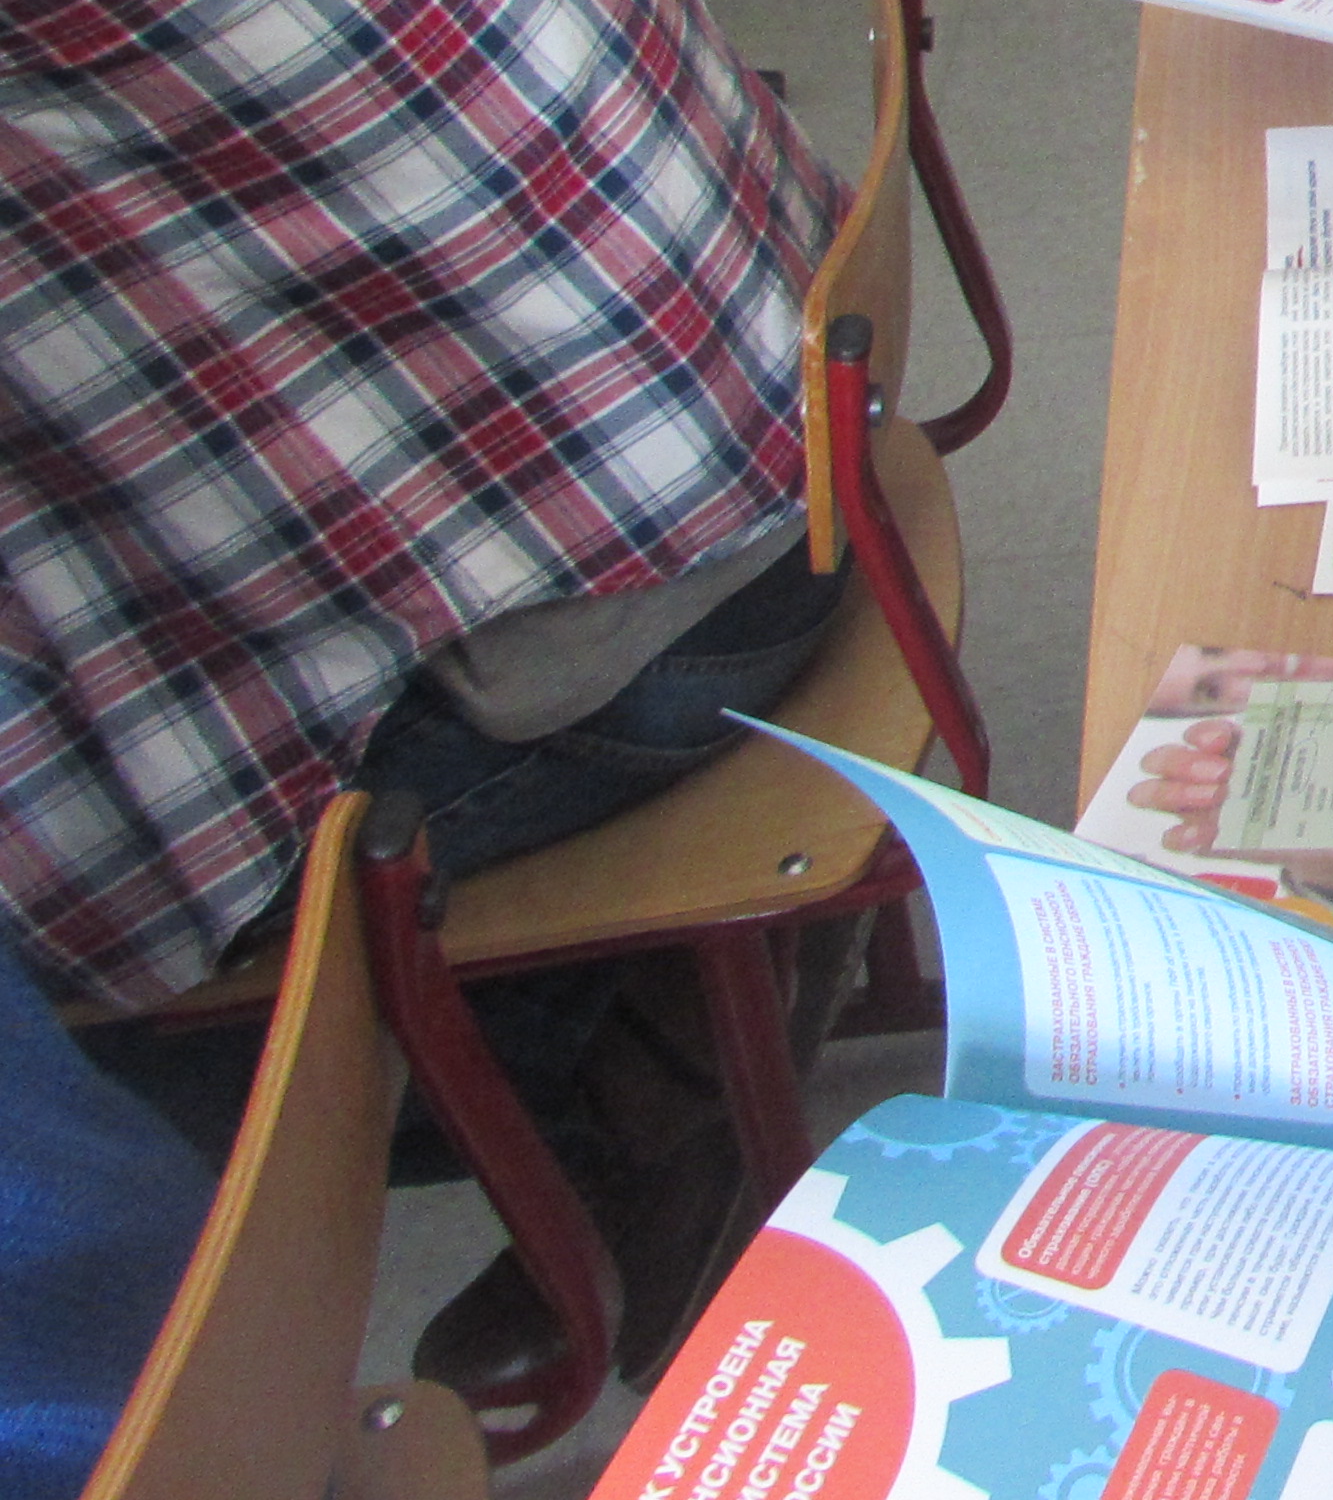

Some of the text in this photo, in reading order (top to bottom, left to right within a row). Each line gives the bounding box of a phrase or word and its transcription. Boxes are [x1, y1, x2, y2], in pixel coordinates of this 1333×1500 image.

[1030, 896, 1054, 943] СИСТЕМЕ
[1072, 925, 1093, 982] ГРАЖДАНЕ
[1044, 890, 1080, 1084] ОБЯЗАТЕЛЬНОГО ПЕНСИОННОГО
[1047, 955, 1063, 1082] ЗАСТРАХОВАННЫЕ
[1080, 985, 1097, 1085] СТРАХОВАНИЯ
[1310, 964, 1332, 1012] ГРАЖДАНЕ
[1284, 988, 1302, 1105] ЗАСТРАХОВАННЫЕ
[1302, 999, 1318, 1107] ОБЯЗАТЕЛЬНОГО
[1018, 1174, 1078, 1260] Обязательное
[1038, 1185, 1092, 1267] страхование
[656, 1320, 776, 1480] УСТРОЕНА
